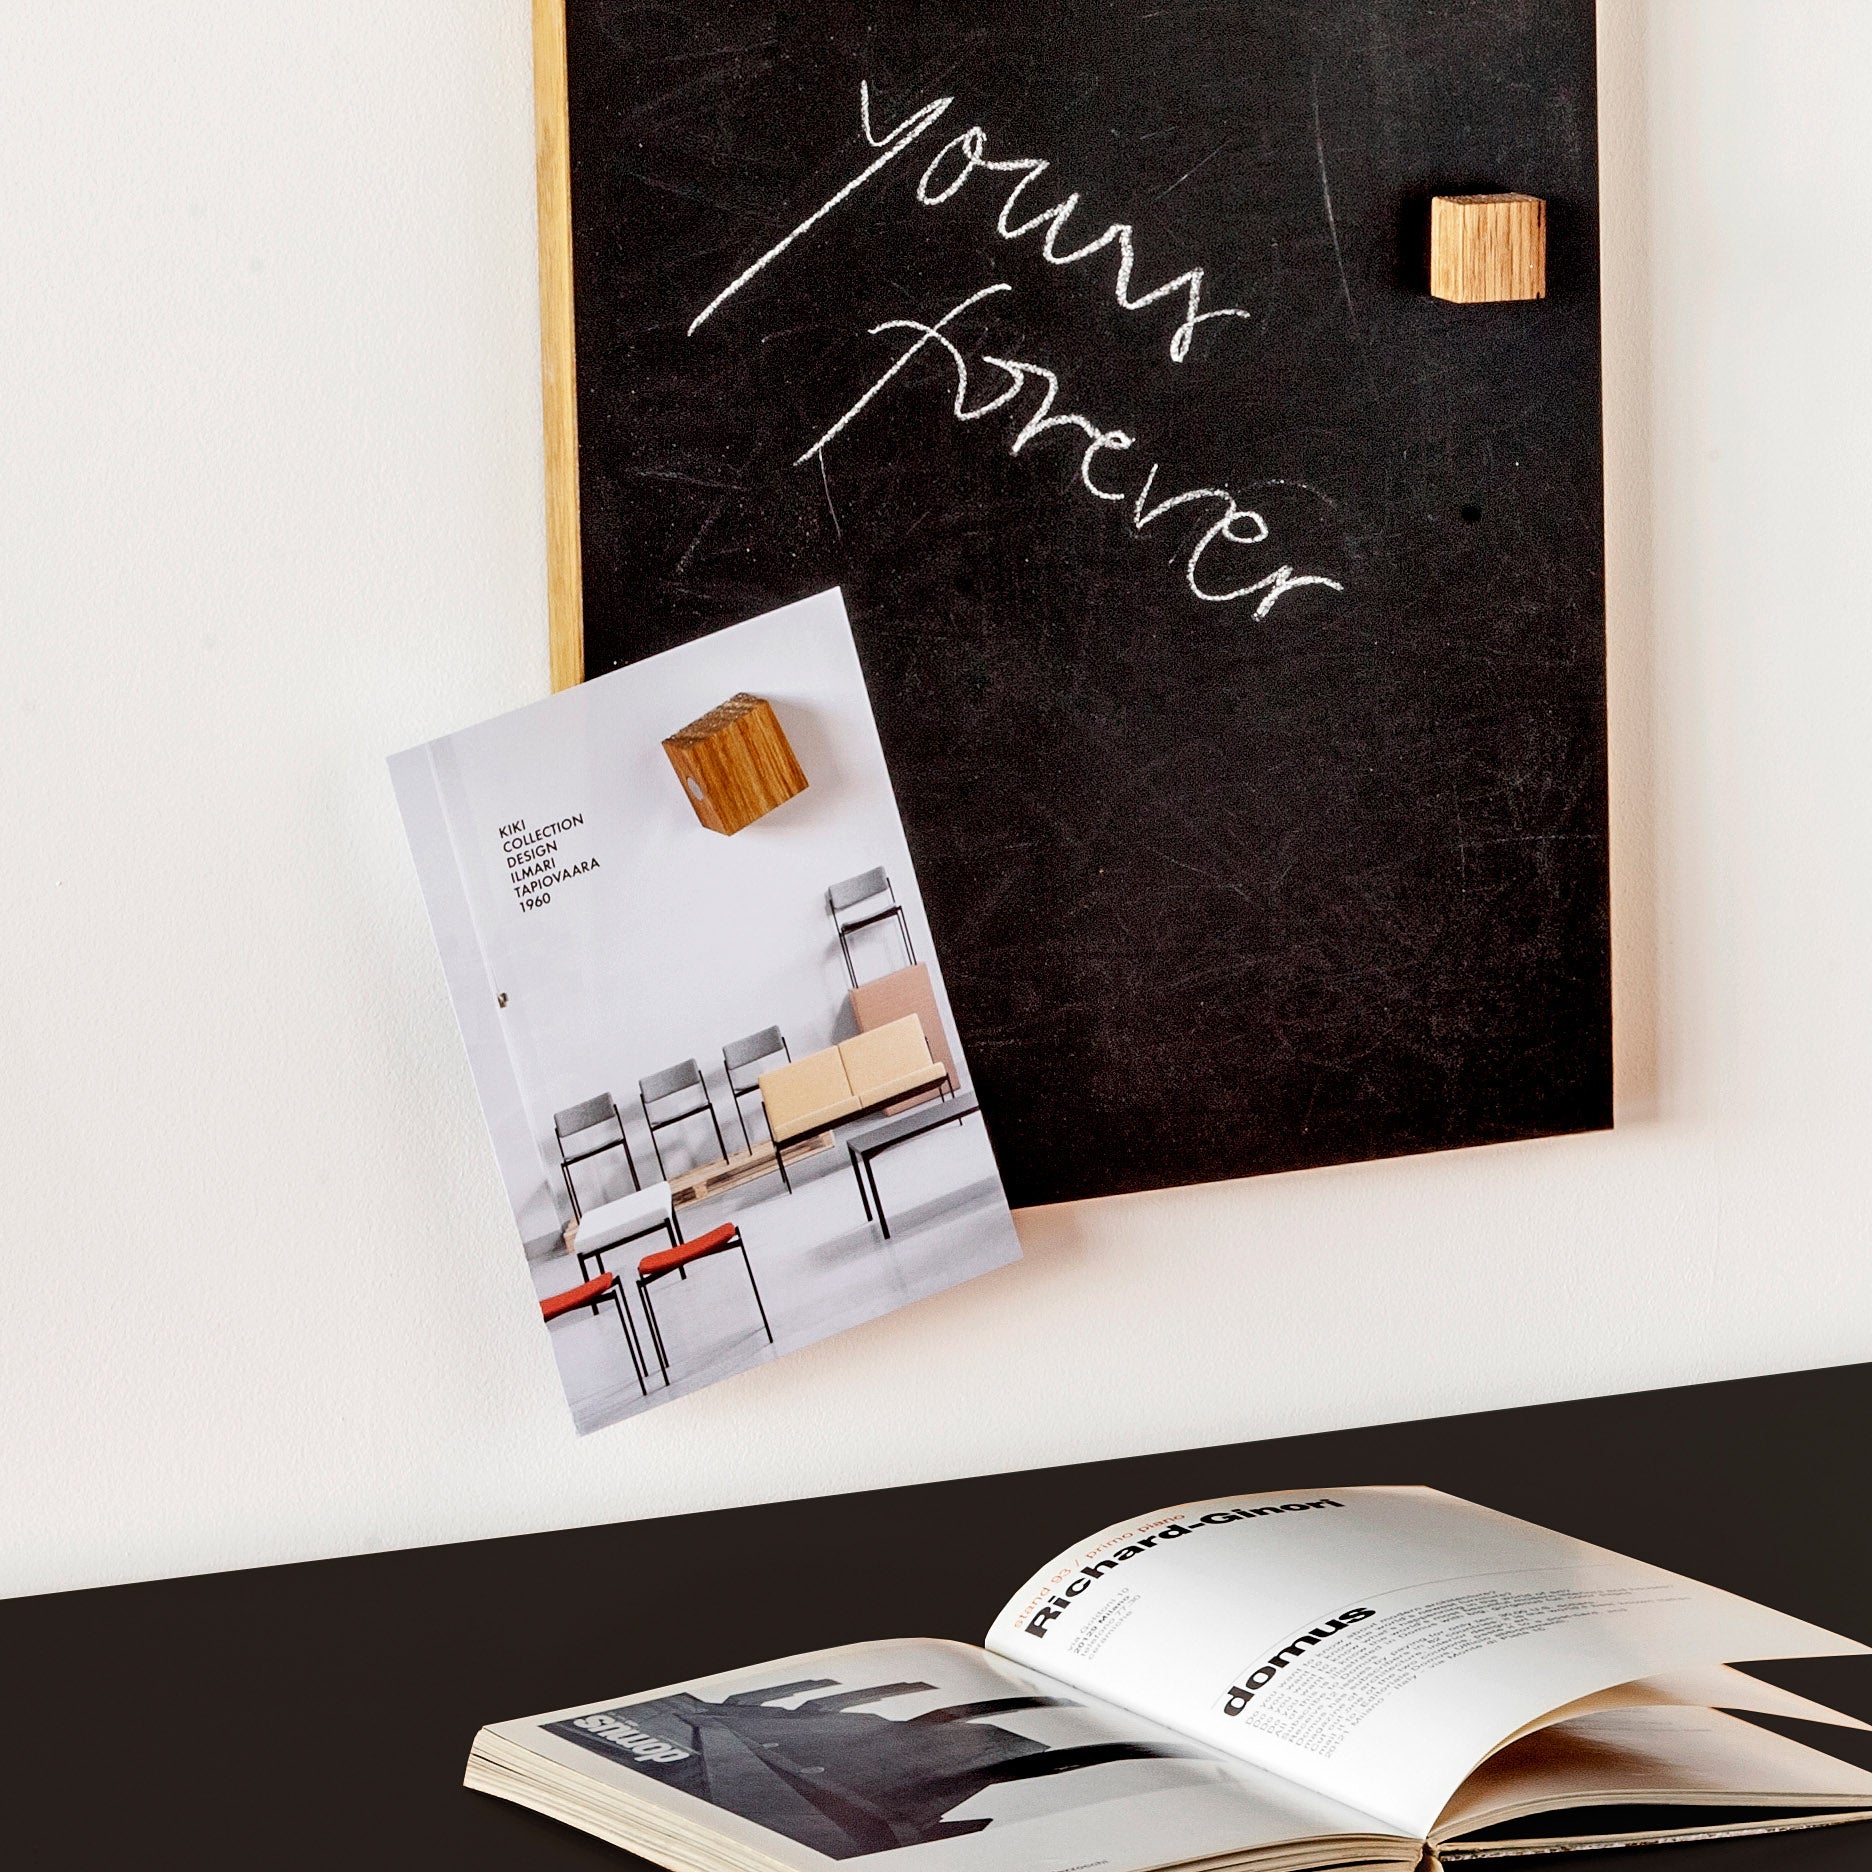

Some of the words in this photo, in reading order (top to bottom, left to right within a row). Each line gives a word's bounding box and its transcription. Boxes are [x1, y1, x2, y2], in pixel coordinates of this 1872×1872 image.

[687, 80, 1251, 363] yours
[794, 283, 1344, 621] forever
[499, 819, 526, 838] KIKI
[503, 813, 584, 853] COLLECTION
[507, 840, 558, 869] DESIGN
[511, 857, 556, 883] ILMARI
[514, 857, 600, 898] TAPIOVAARA
[519, 892, 551, 912] 1960
[1013, 1587, 1051, 1629] stand
[1051, 1568, 1072, 1584] 93
[1085, 1532, 1134, 1559] primo
[1137, 1513, 1186, 1534] piano
[1025, 1498, 1346, 1638] Richard-Ginori
[1223, 1607, 1376, 1717] domus
[573, 1715, 692, 1763] domus
